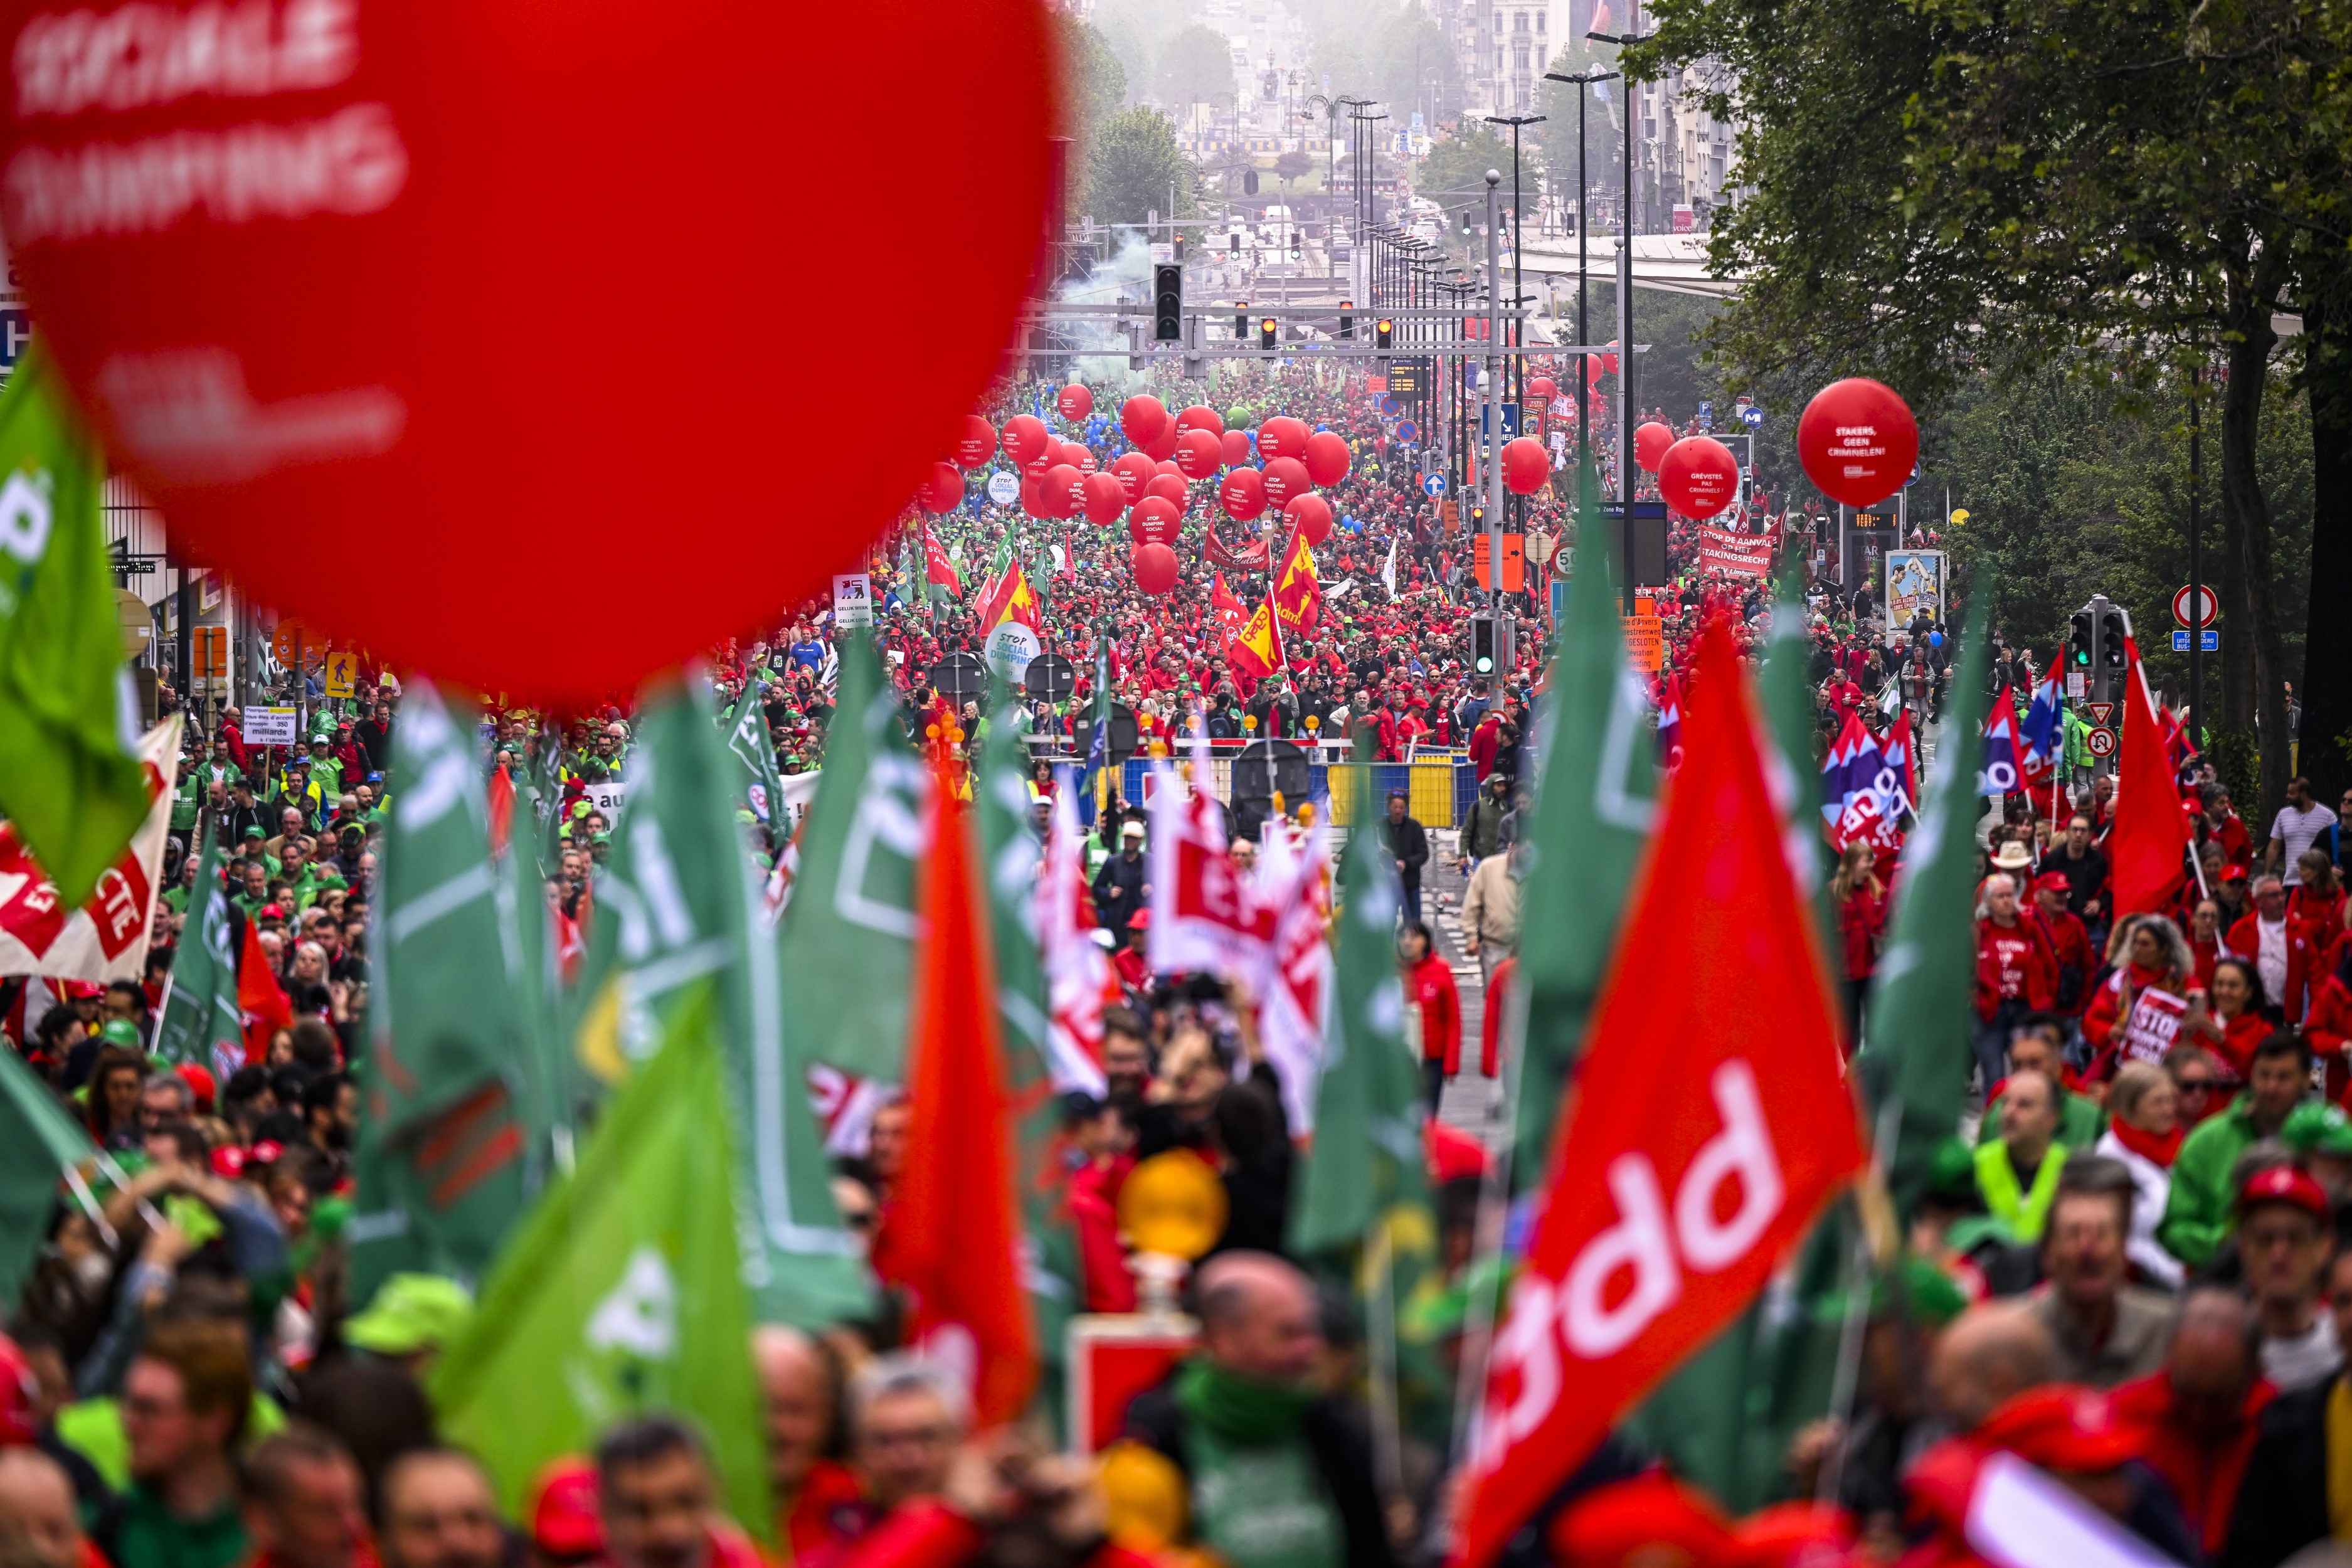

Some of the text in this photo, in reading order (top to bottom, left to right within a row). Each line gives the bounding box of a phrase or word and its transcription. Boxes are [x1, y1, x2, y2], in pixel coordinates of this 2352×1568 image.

[1836, 426, 1877, 436] STAKERS,
[1843, 438, 1870, 447] GEEN
[1703, 531, 1723, 541] STOP
[1737, 538, 1772, 548] AANVAL
[1000, 633, 1027, 645] STOP
[997, 642, 1029, 656] SOCIAL
